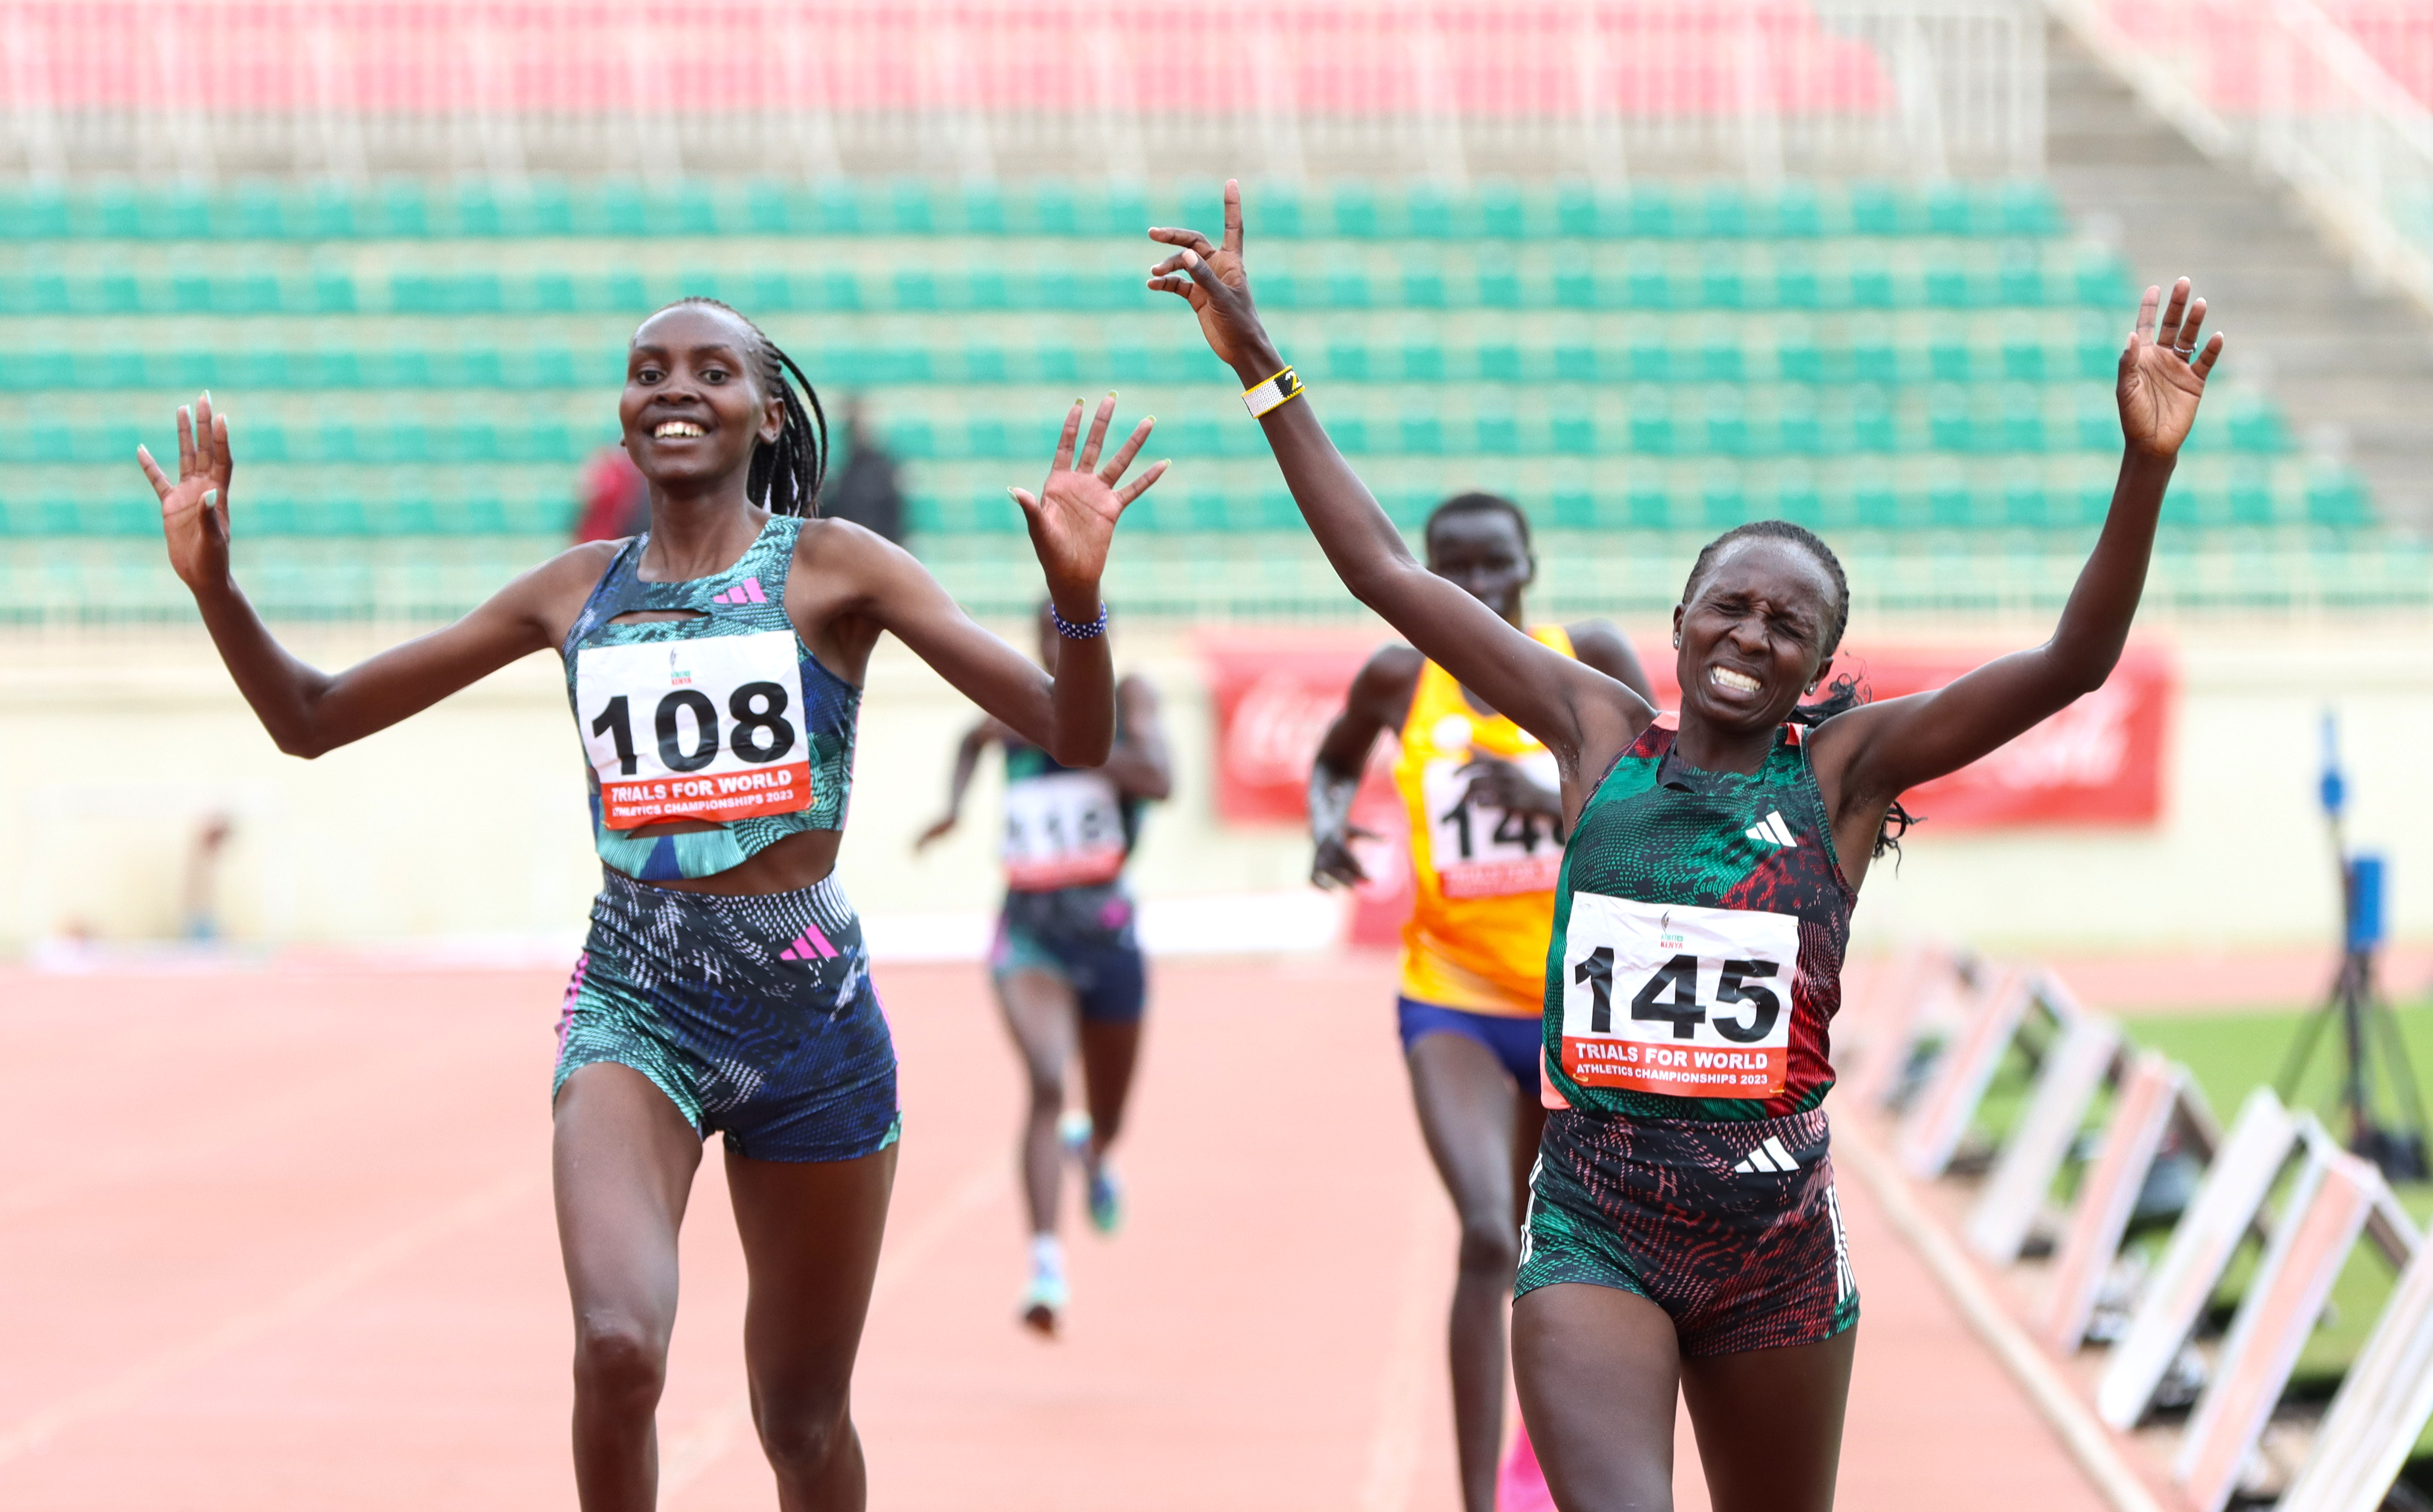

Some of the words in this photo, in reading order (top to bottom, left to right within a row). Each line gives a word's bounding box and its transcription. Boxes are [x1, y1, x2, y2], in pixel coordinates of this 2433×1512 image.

[592, 681, 795, 776] 108
[611, 784, 667, 802] TRIALS
[672, 779, 714, 798] FOR
[717, 769, 792, 793] WORLD
[664, 793, 764, 814] CHAMPIONSHIPS
[766, 789, 794, 803] 2023
[1661, 941, 1683, 949] KENYA
[1575, 946, 1781, 1043] 145
[1575, 1043, 1638, 1063] TRIALS
[1645, 1048, 1688, 1067] FOR
[1694, 1052, 1768, 1069] WORLD
[1577, 1064, 1633, 1077] ATHLETICS
[1635, 1068, 1737, 1085] CHAMPIONSHIPS
[1740, 1074, 1768, 1085] 2023
